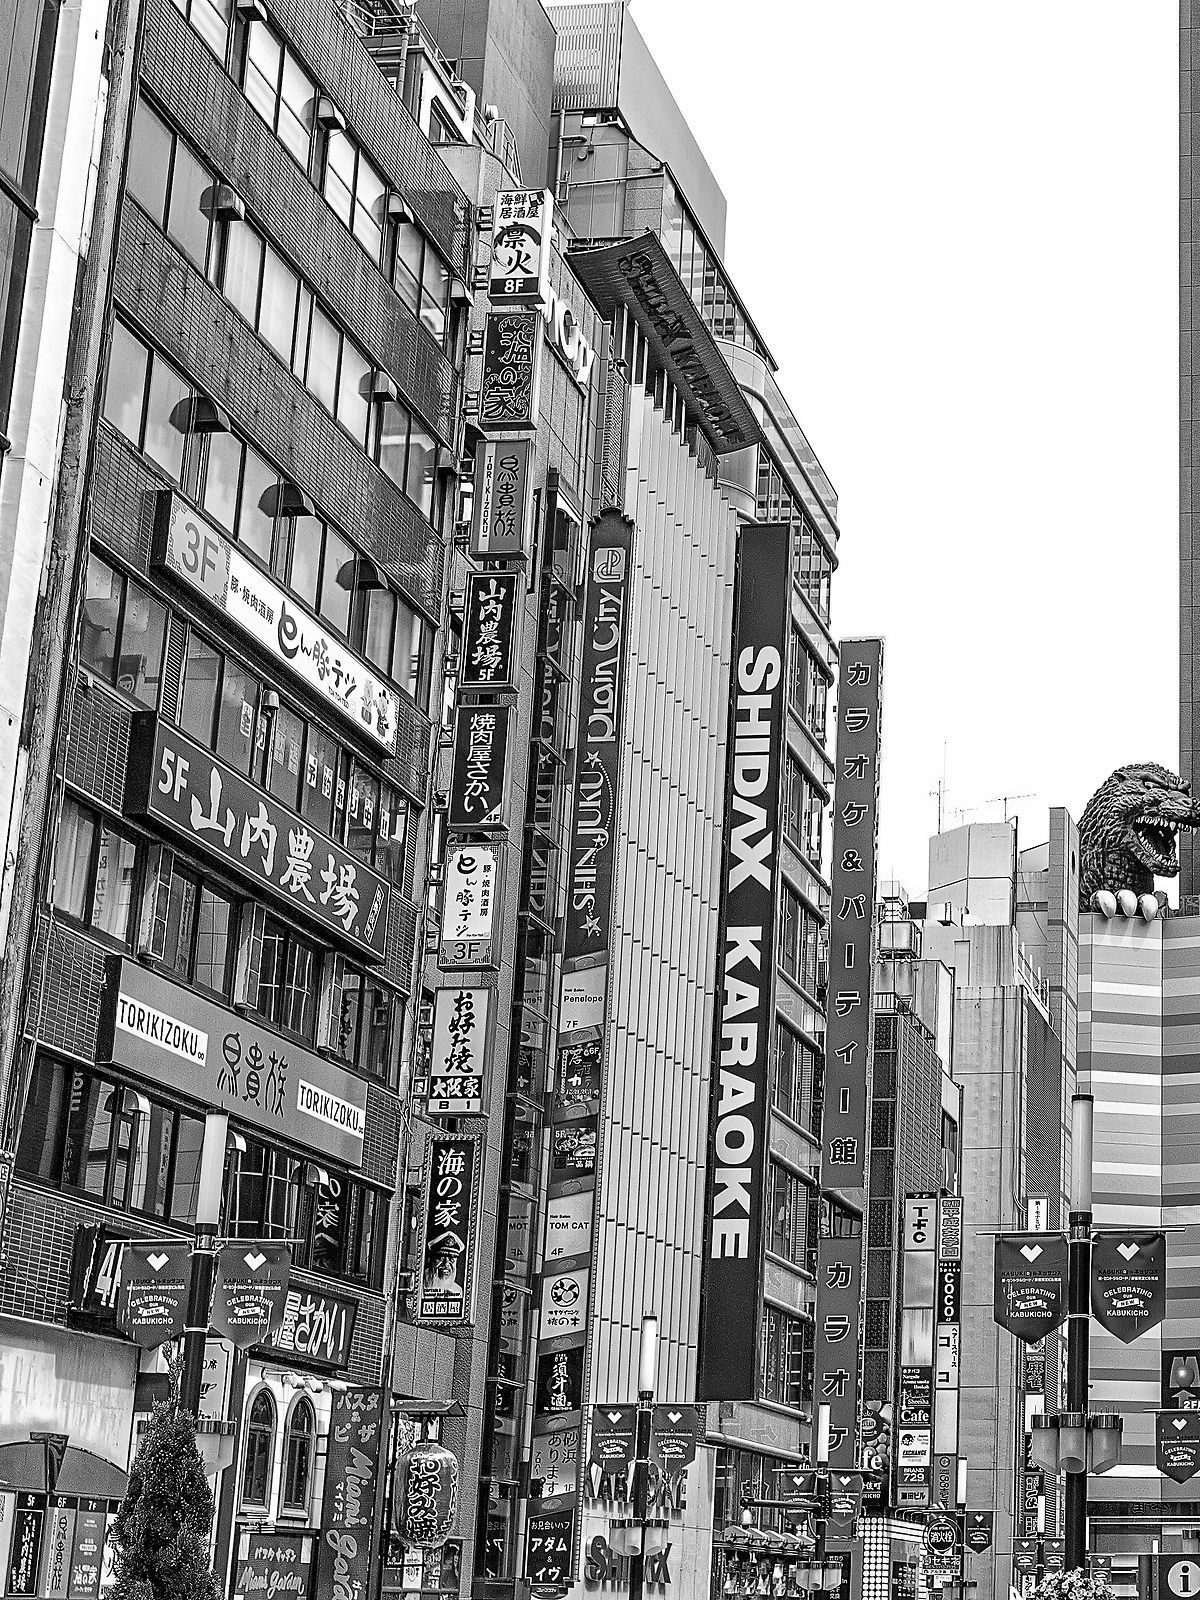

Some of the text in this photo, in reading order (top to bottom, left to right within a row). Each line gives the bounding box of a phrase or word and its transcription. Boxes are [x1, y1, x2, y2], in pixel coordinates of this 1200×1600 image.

[499, 206, 540, 219] 居酒屋
[504, 280, 524, 294] 8F
[481, 454, 494, 534] TORIKIZOKU
[493, 454, 520, 537] 鳥貴族
[181, 522, 219, 582] 3F
[471, 577, 507, 669] 山内農場
[478, 668, 495, 681] 5F
[464, 713, 496, 814] 焼肉屋さかい
[485, 813, 501, 823] 4F
[158, 746, 190, 802] 5F
[190, 766, 360, 932] 山内農場
[572, 770, 608, 912] SHINJUKU
[829, 661, 872, 1165] カラオケ&パーティー館
[453, 942, 480, 960] 3F
[711, 645, 782, 1260] SHIDAX KARAOKE
[566, 1020, 579, 1028] 7F
[119, 998, 360, 1131] TORIKIZOKU 鳥貴族 TORIKIZOKU
[432, 1076, 479, 1098] 大阪家
[435, 1148, 466, 1228] 海の家
[551, 1248, 564, 1256] 4F
[943, 1272, 955, 1317] COCO
[1006, 1287, 1056, 1300] CELEBRATING
[1103, 1286, 1153, 1299] CELEBRATING
[130, 1295, 179, 1308] CELEBRATING
[226, 1295, 274, 1308] CELEBRATING
[132, 1316, 174, 1325] KABUKICHO
[1106, 1309, 1149, 1317] KABUKICHO
[227, 1317, 269, 1325] KABUKICHO
[821, 1262, 852, 1452] カラオケ
[337, 1393, 379, 1411] パスタ
[900, 1409, 930, 1422] Cafe
[333, 1424, 376, 1443] ピザ
[546, 1431, 563, 1496] あります
[903, 1473, 925, 1482] 729
[563, 1483, 574, 1491] 1F
[27, 1494, 36, 1507] 5F
[57, 1496, 67, 1508] 6F
[88, 1500, 97, 1511] 7F
[930, 1531, 953, 1543] 消火栓
[531, 1537, 568, 1553] アダム
[535, 1566, 562, 1582] イヴ
